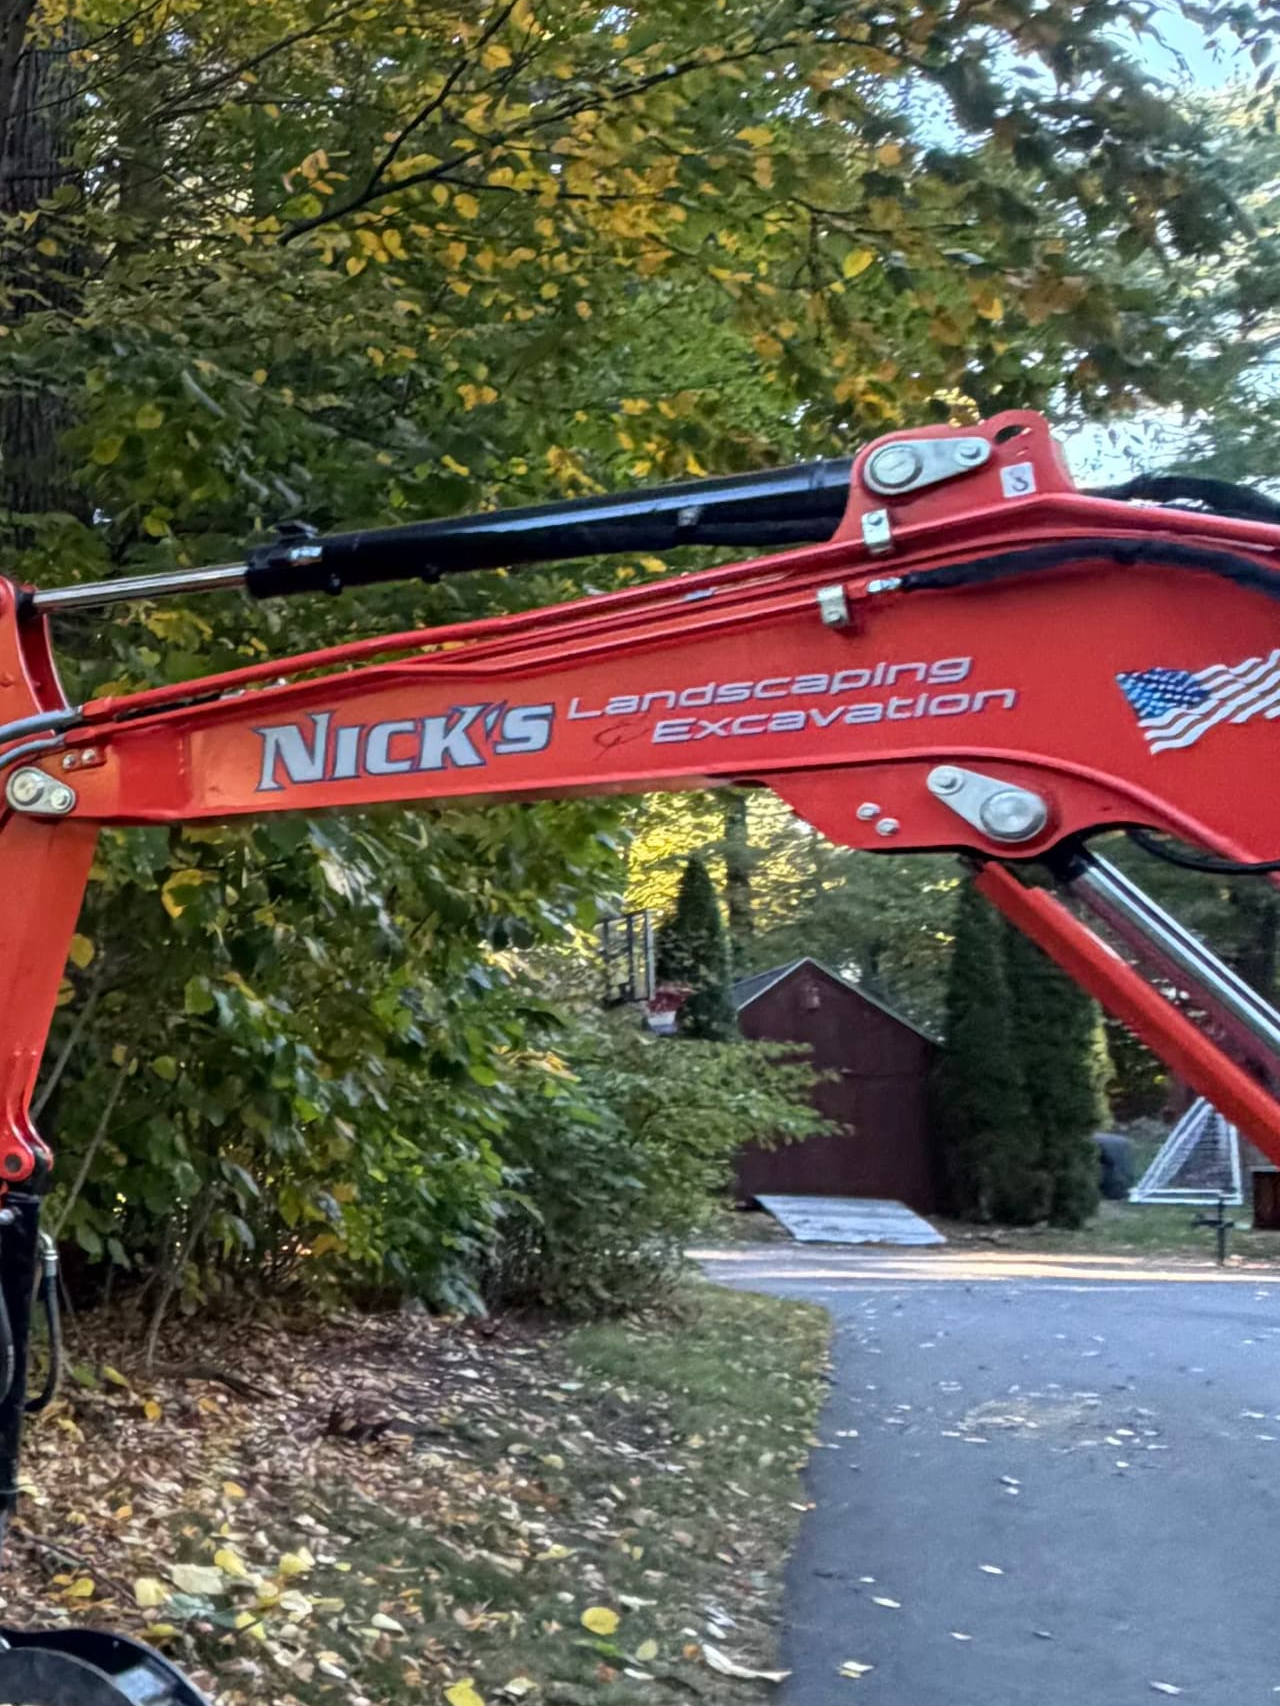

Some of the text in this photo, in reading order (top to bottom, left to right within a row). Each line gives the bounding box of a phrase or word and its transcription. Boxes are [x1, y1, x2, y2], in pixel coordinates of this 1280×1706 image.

[567, 656, 972, 720] Landscaping
[651, 688, 1017, 744] Excavation
[252, 700, 555, 791] NICK'S
